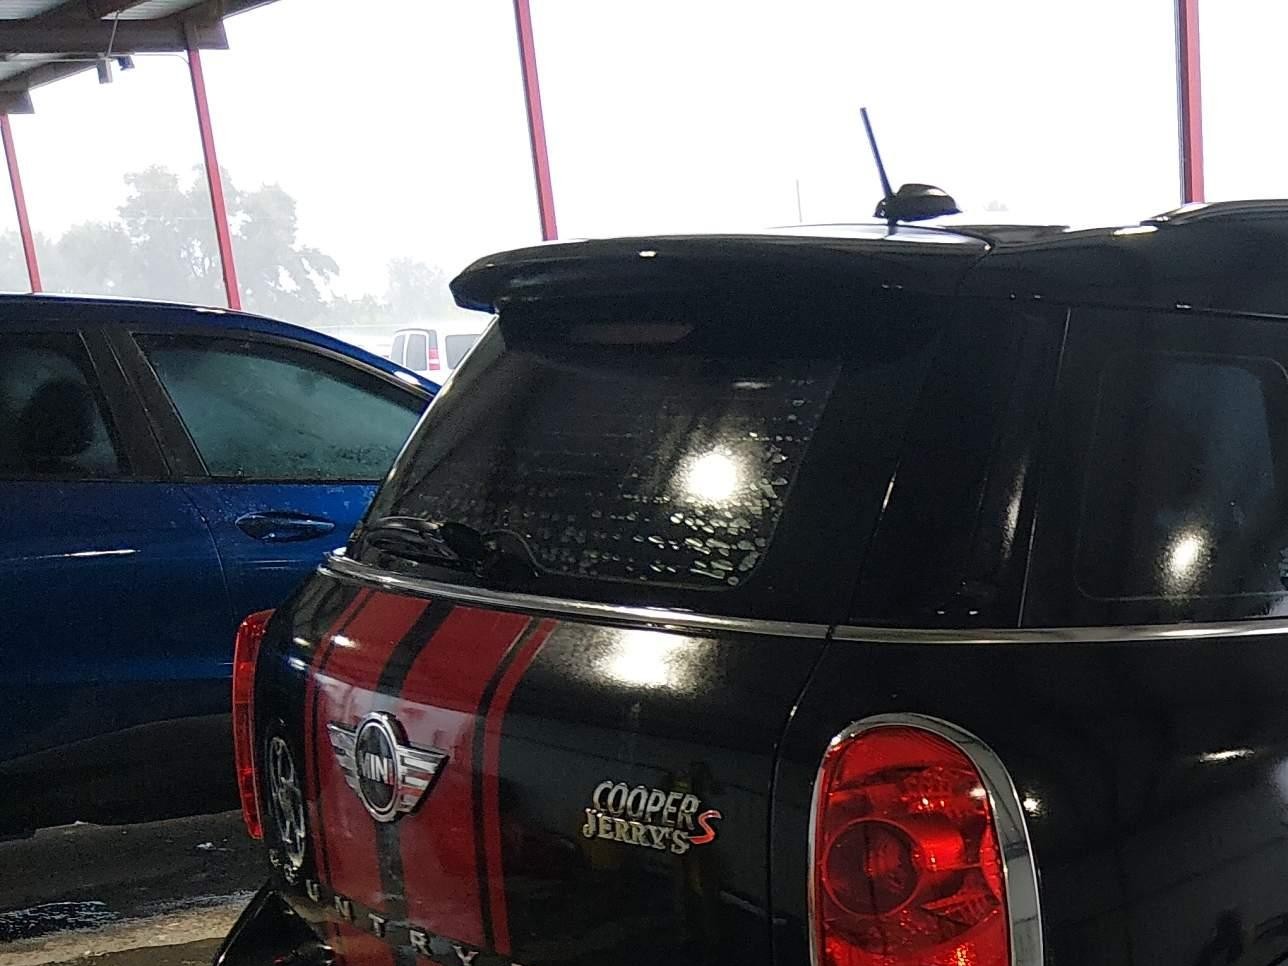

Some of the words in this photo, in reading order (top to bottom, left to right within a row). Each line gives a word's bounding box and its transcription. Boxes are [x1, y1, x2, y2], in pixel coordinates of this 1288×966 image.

[358, 749, 394, 785] MINI
[582, 807, 691, 856] JERRY'S
[592, 779, 701, 832] COOPER
[687, 808, 723, 846] S
